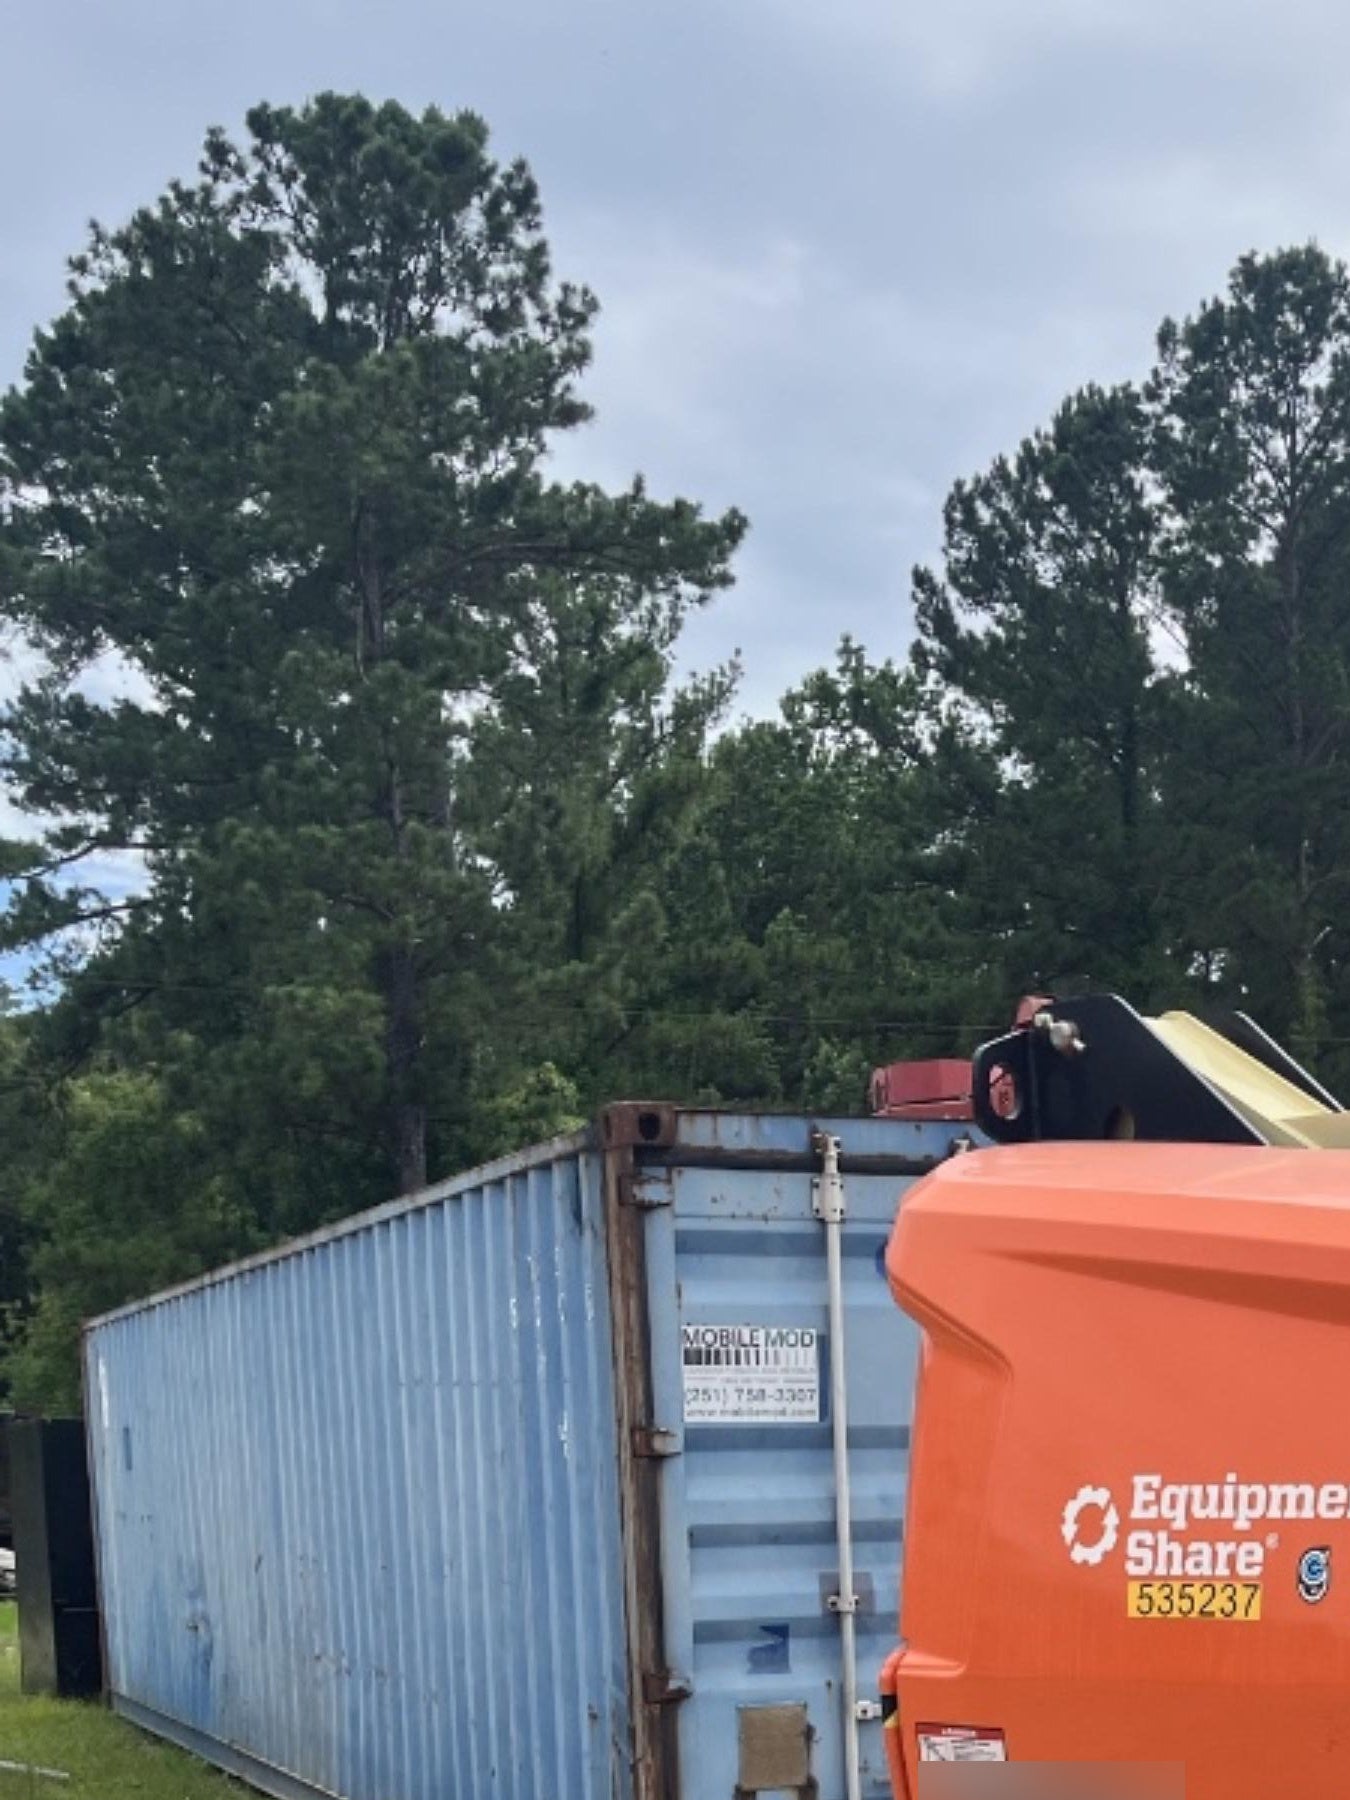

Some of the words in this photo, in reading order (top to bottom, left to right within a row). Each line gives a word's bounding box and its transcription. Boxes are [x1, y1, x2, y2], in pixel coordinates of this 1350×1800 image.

[682, 1327, 760, 1348] MOBILE
[764, 1329, 814, 1348] MOD
[1125, 1529, 1264, 1577] Share
[1136, 1582, 1260, 1618] 535237
